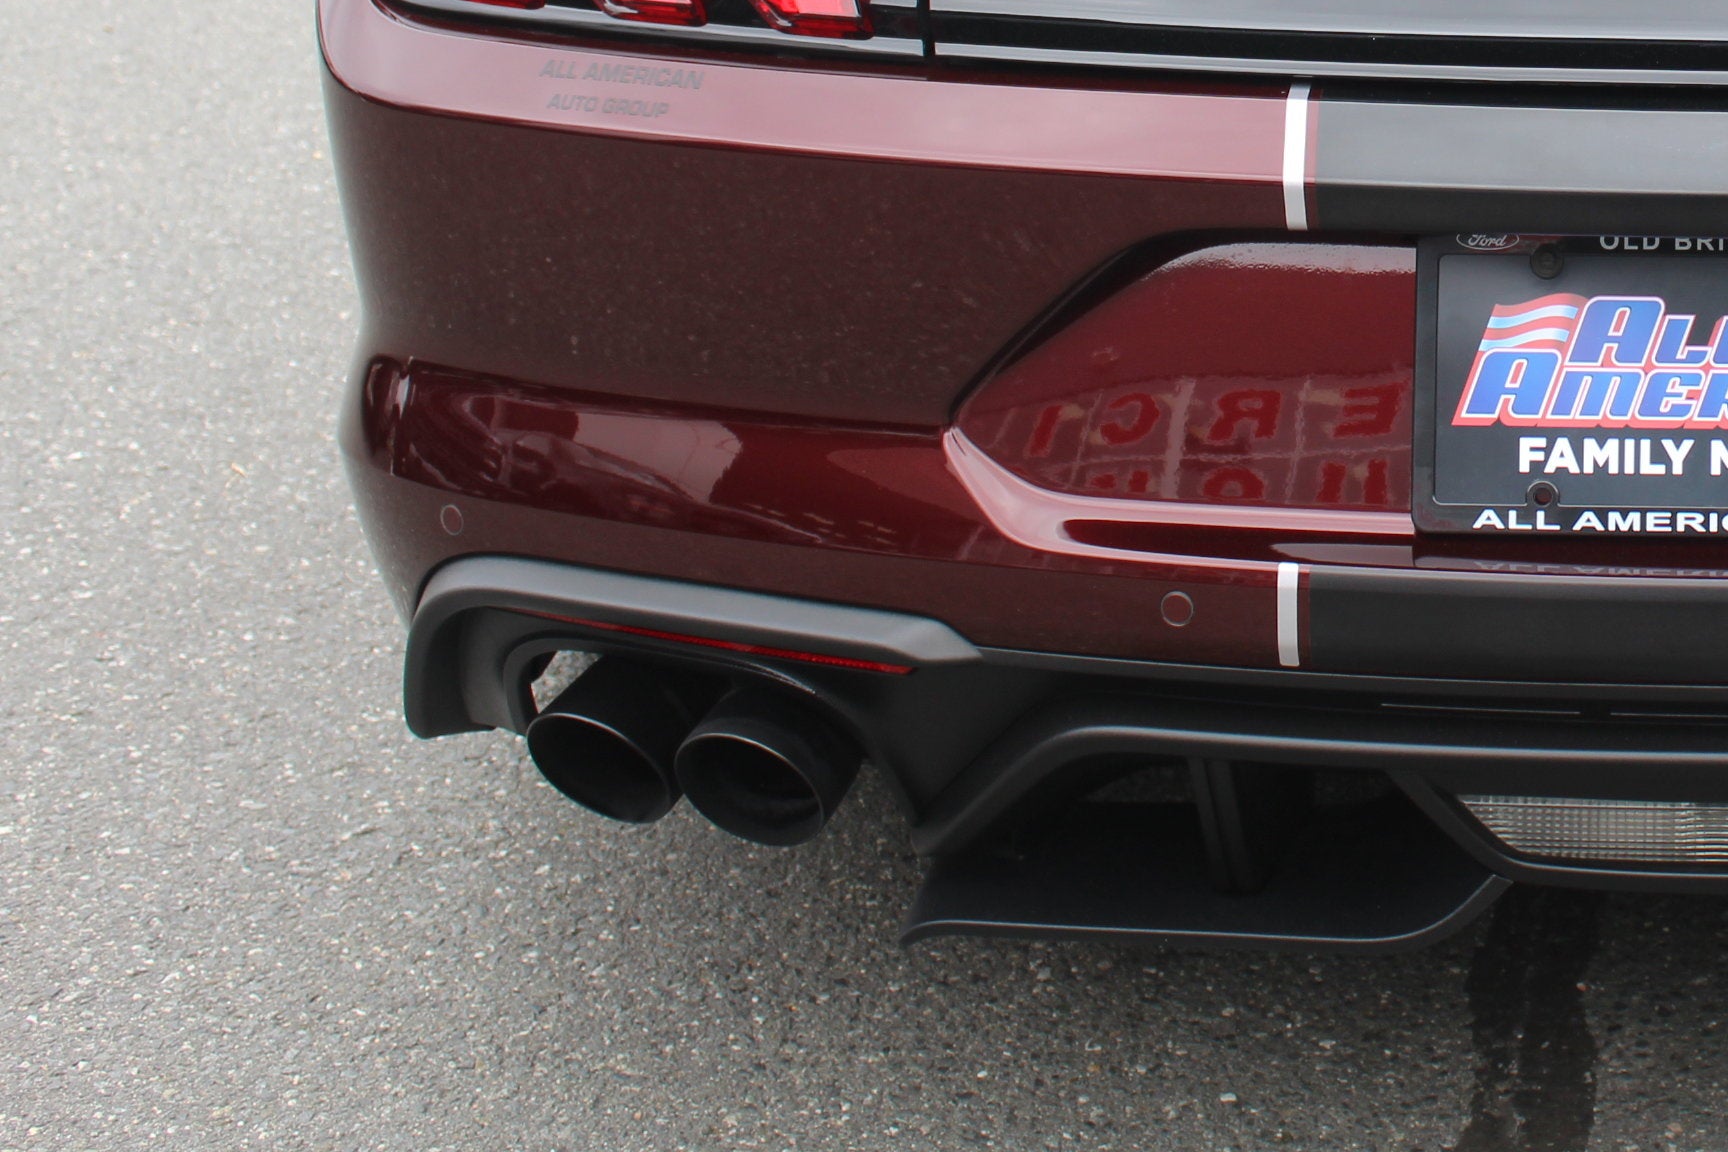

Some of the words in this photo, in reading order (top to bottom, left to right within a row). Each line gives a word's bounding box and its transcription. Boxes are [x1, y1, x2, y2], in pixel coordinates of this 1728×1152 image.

[539, 59, 577, 79] ALL
[582, 62, 705, 90] AMERICAN
[546, 93, 597, 112] AUTO
[602, 97, 670, 118] GROUP
[1518, 437, 1695, 476] FAMILY
[1472, 509, 1560, 531] ALL
